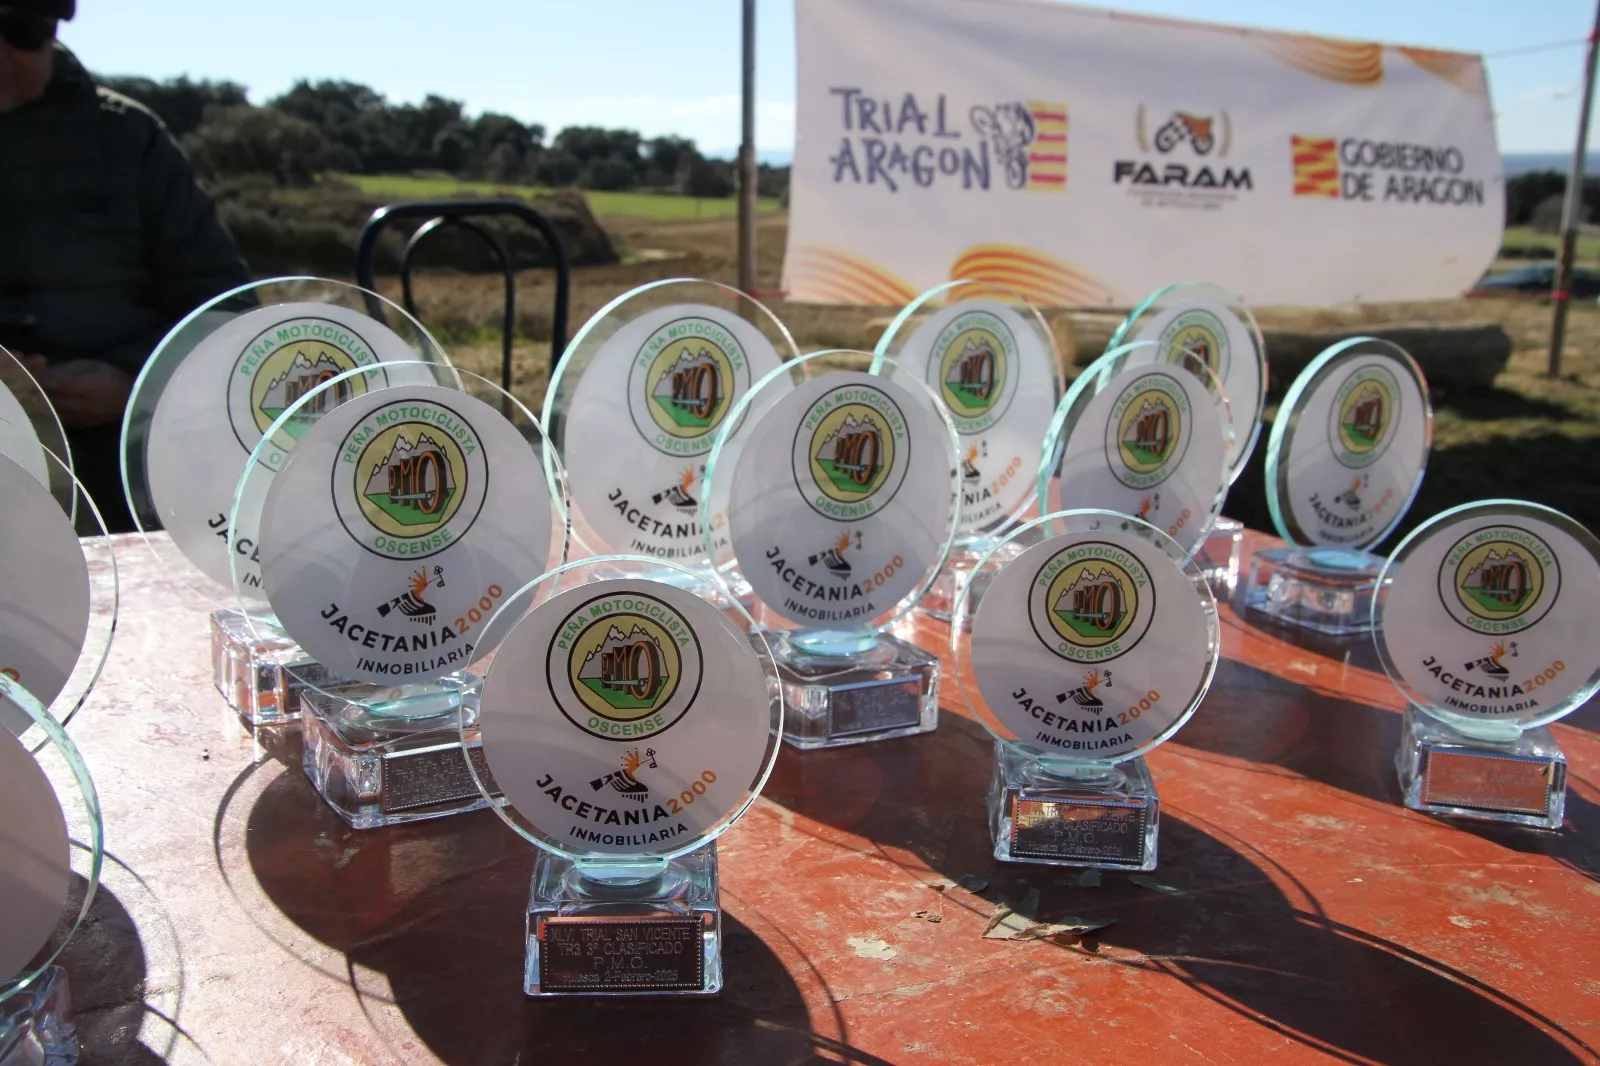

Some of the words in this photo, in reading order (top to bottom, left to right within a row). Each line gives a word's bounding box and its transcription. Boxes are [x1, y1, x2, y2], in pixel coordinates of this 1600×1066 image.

[829, 87, 961, 139] TRIAL
[829, 137, 990, 192] ARAGON
[1340, 138, 1464, 174] GOBIERNO
[1114, 160, 1253, 191] FARAM
[1342, 170, 1375, 201] DE
[1383, 175, 1484, 207] ARAGON
[276, 324, 378, 379] MOTOCICLISTA
[835, 389, 904, 440] MOTOCICLISTA
[342, 427, 374, 464] PEÑA
[375, 406, 476, 456] MOTOCICLISTA
[815, 496, 875, 517] OSCENSE
[374, 528, 454, 556] OSCENSE
[1039, 558, 1066, 587] PEÑA
[1067, 547, 1145, 588] MOTOCICLISTA
[558, 614, 588, 650] PEÑA
[590, 599, 691, 648] MOTOCICLISTA
[784, 598, 876, 622] INMOBILIARIA
[1466, 616, 1528, 632] OSCENSE
[356, 643, 474, 676] INMOBILIARIA
[1058, 642, 1121, 660] OSCENSE
[1445, 695, 1539, 714] INMOBILIARIA
[587, 714, 666, 736] OSCENSE
[1035, 731, 1133, 750] INMOBILIARIA
[569, 822, 688, 846] INMOBILIARIA
[579, 927, 611, 942] TRIAL
[616, 927, 638, 941] SAN
[642, 927, 691, 941] VICENTE
[604, 941, 683, 955] CLASIFICADO
